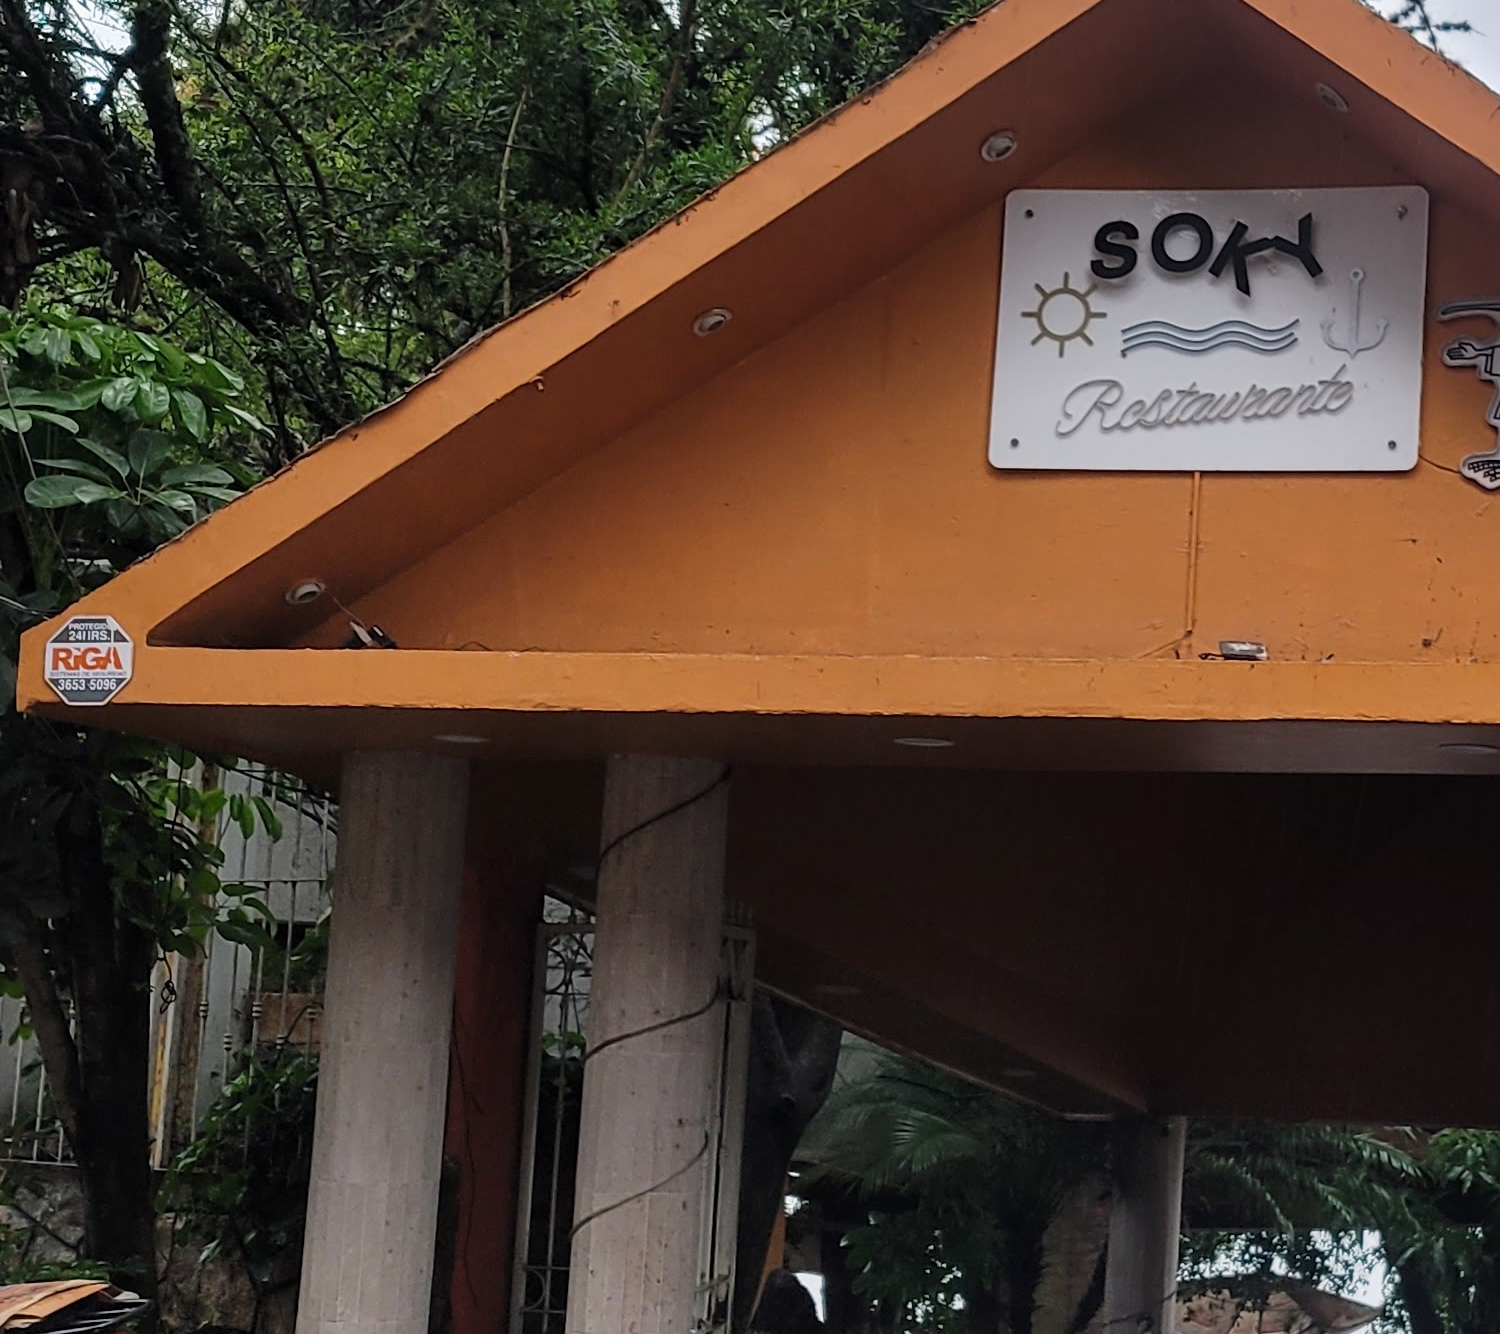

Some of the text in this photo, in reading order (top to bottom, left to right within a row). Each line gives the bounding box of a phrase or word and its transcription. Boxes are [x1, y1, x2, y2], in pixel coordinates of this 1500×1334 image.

[1090, 212, 1323, 298] SOKY
[1055, 362, 1355, 438] Restaurante
[58, 678, 117, 690] 3653 5096
